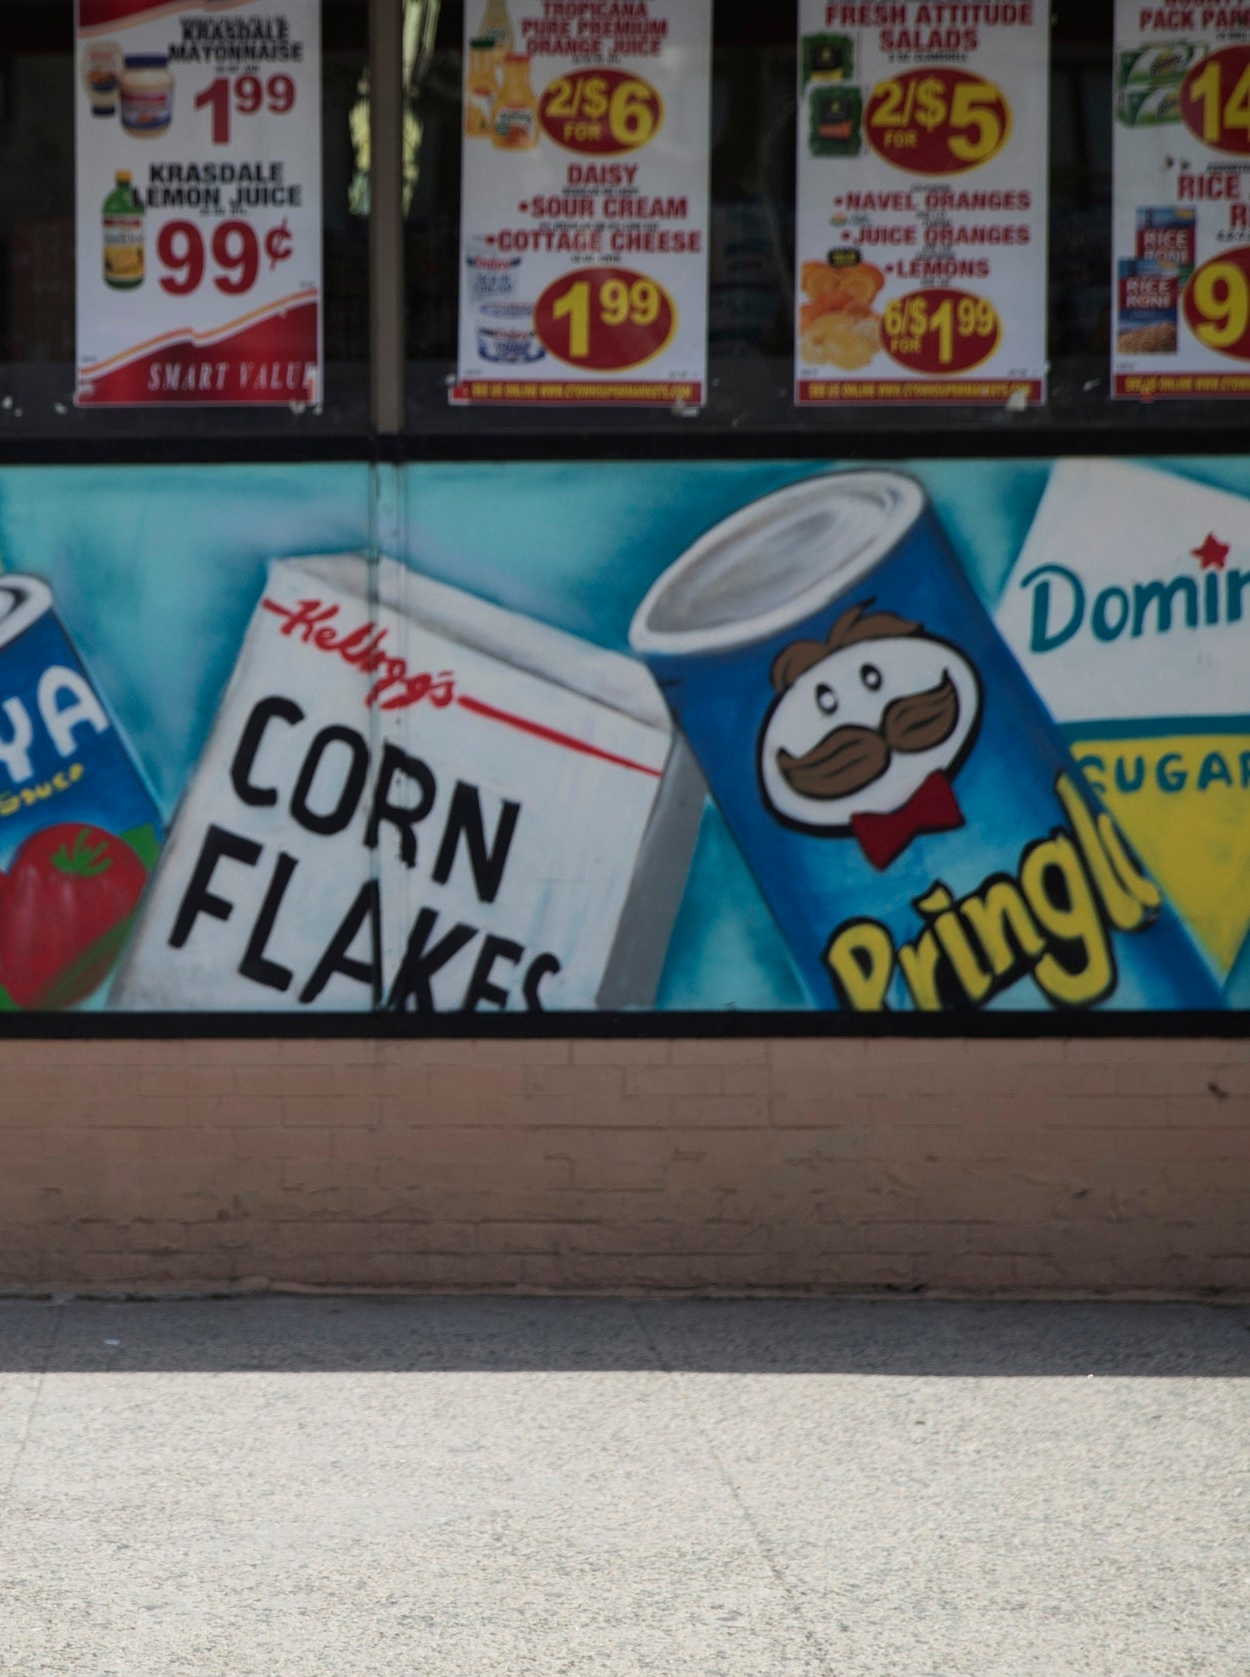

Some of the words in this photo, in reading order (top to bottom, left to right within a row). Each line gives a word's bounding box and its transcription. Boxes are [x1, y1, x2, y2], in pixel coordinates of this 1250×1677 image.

[543, 1, 647, 17] TROPICANA
[825, 4, 905, 26] FRESH
[915, 3, 1033, 26] ATTITUDE
[1140, 7, 1194, 30] PACK
[522, 18, 570, 36] PURE
[578, 18, 667, 35] PREMIUM
[527, 38, 602, 55] ORANGE
[611, 38, 662, 55] JUICE
[879, 29, 978, 51] SALADS
[168, 44, 303, 63] MAYONNAISE
[563, 122, 600, 141] FOR
[883, 129, 918, 148] FOR
[150, 162, 285, 183] KRASDALE
[567, 164, 638, 185] DAISY
[132, 186, 219, 208] LEMON
[231, 186, 301, 208] JUICE
[1178, 175, 1240, 200] RICE
[532, 197, 594, 218] SOUR
[603, 197, 688, 218] CREAM
[846, 190, 917, 211] NAVEL
[925, 191, 1031, 211] ORANGES
[499, 231, 600, 252] COTTAGE
[611, 230, 701, 252] CHEESE
[853, 225, 916, 246] JUICE
[924, 225, 1030, 245] ORANGES
[1143, 228, 1189, 247] RICE
[896, 258, 990, 279] LEMONS
[1126, 277, 1171, 294] RICE
[148, 361, 230, 391] SMART
[230, 696, 521, 902] CORN
